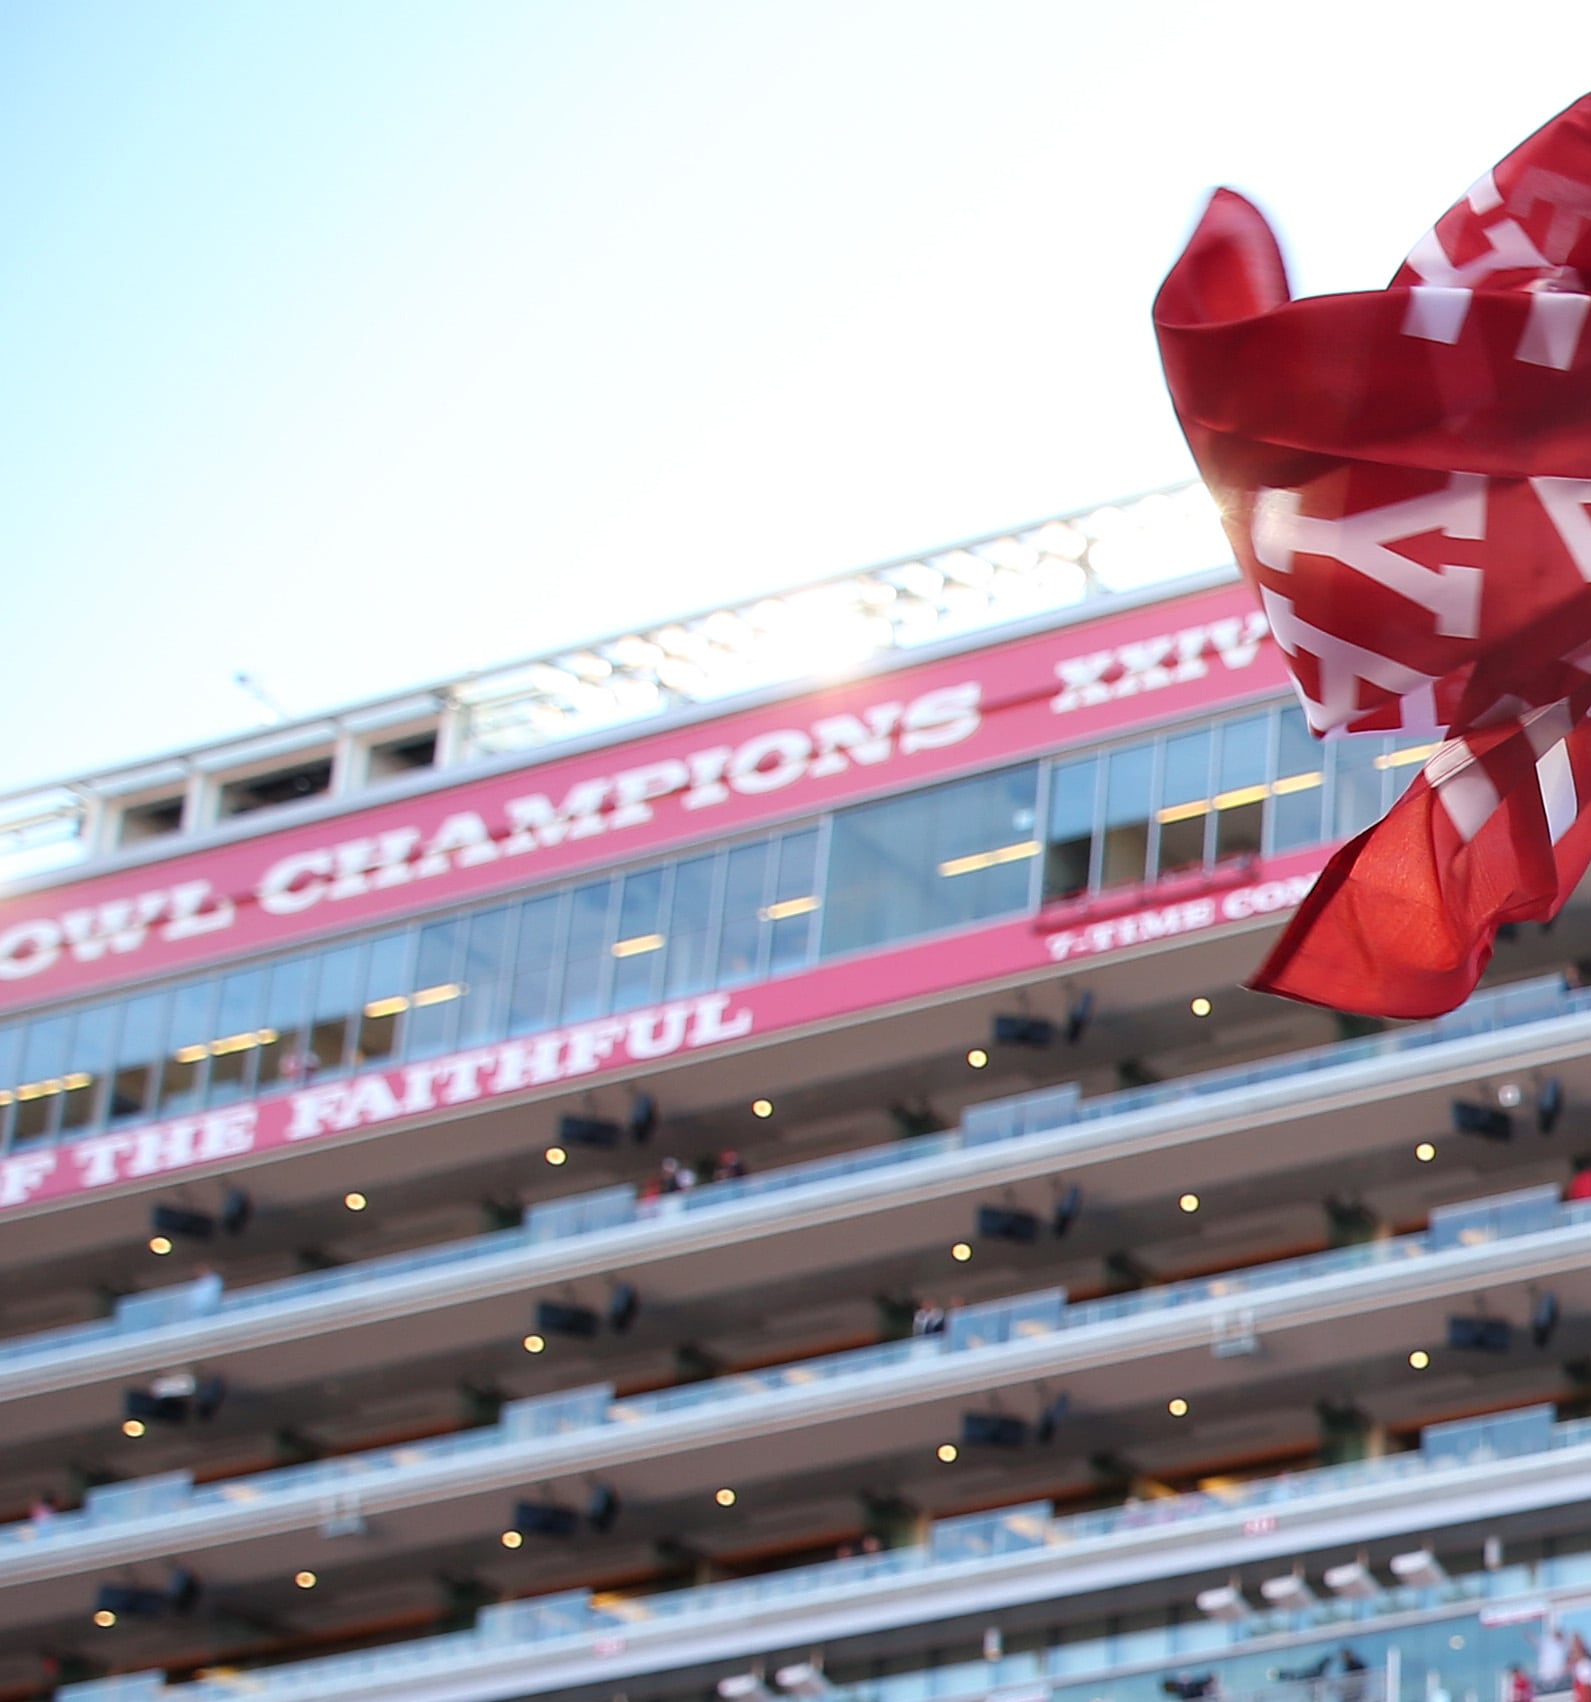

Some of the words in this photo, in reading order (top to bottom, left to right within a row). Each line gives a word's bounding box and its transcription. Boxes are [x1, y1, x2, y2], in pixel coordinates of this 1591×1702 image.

[256, 680, 984, 916] CHAMPIONS
[1050, 610, 1270, 715] XXIV
[1045, 897, 1216, 961] 7-TIME
[73, 1102, 258, 1190] THE
[287, 993, 754, 1142] FAITHFUL
